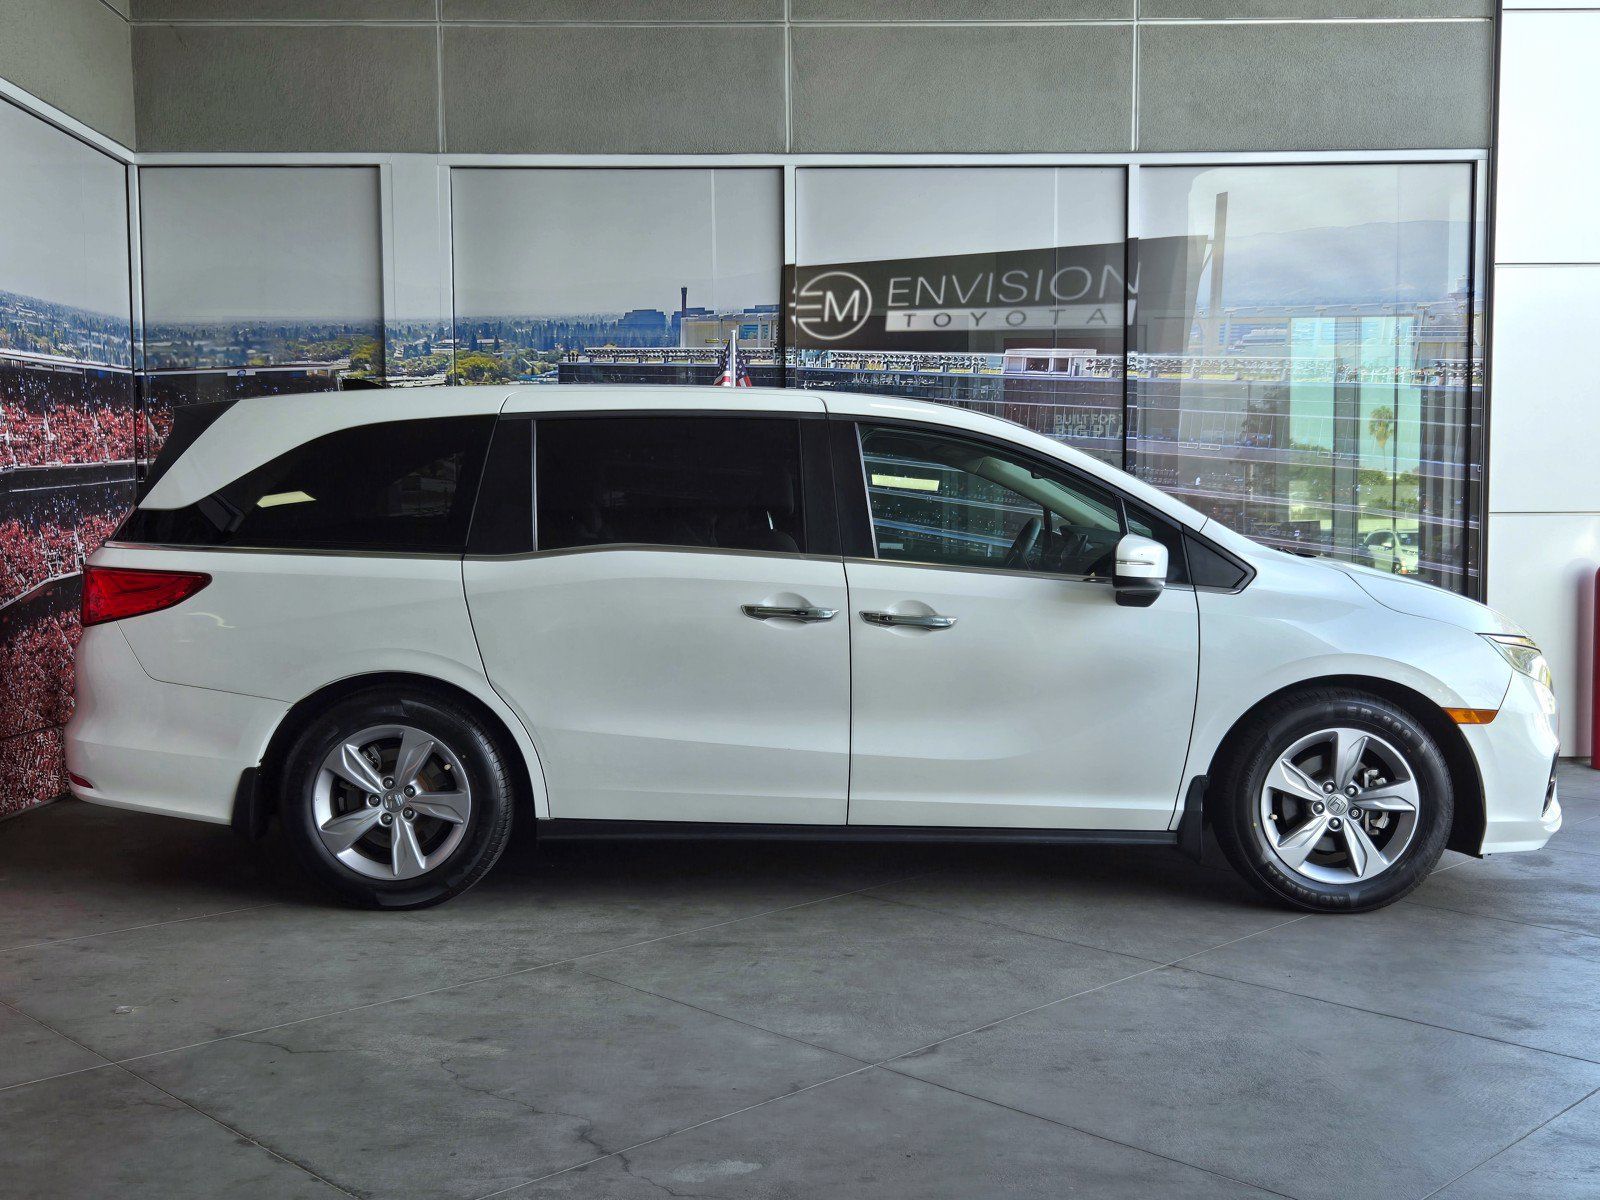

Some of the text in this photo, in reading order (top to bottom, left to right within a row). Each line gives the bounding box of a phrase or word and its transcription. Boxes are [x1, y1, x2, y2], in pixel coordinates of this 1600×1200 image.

[887, 261, 1141, 307] ENVISION
[902, 307, 1108, 328] TOYOTA
[1055, 413, 1089, 425] BUILT
[1090, 414, 1117, 425] FOR
